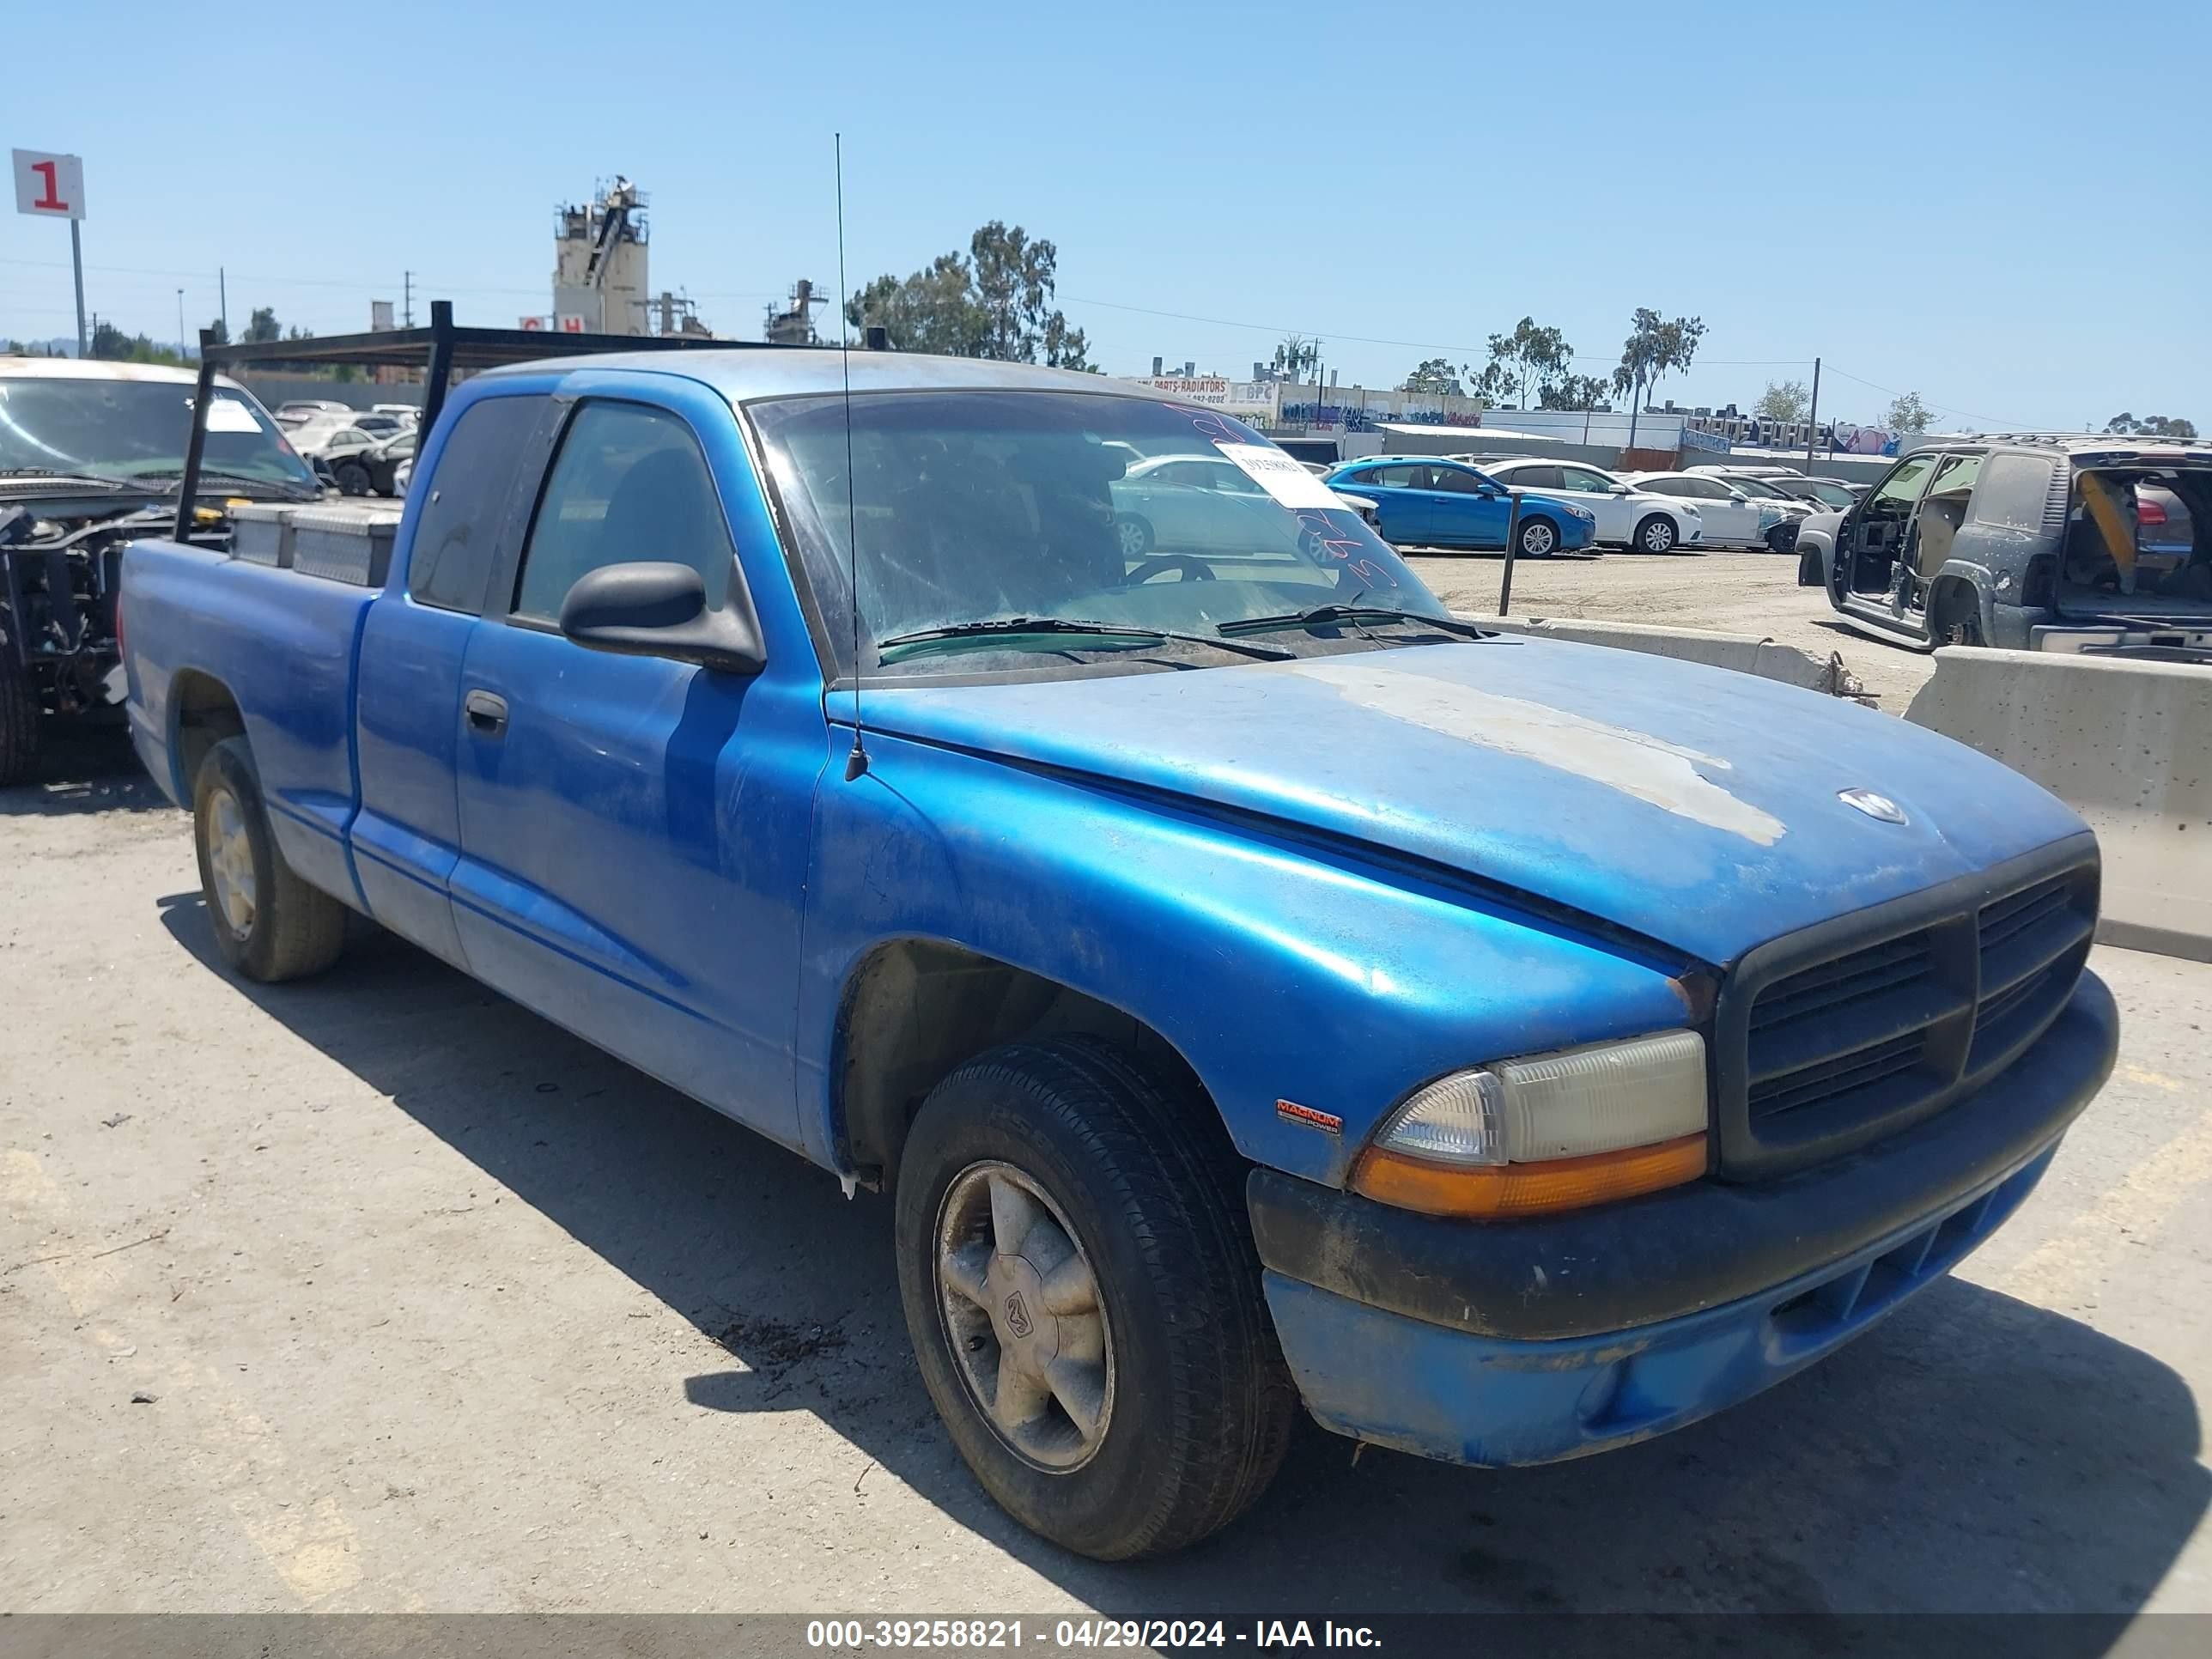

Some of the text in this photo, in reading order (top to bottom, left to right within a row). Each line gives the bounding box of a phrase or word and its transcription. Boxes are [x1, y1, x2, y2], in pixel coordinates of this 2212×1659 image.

[32, 161, 69, 211] 1
[1277, 1102, 1340, 1127] MAGNUM
[1307, 1119, 1338, 1133] POWER
